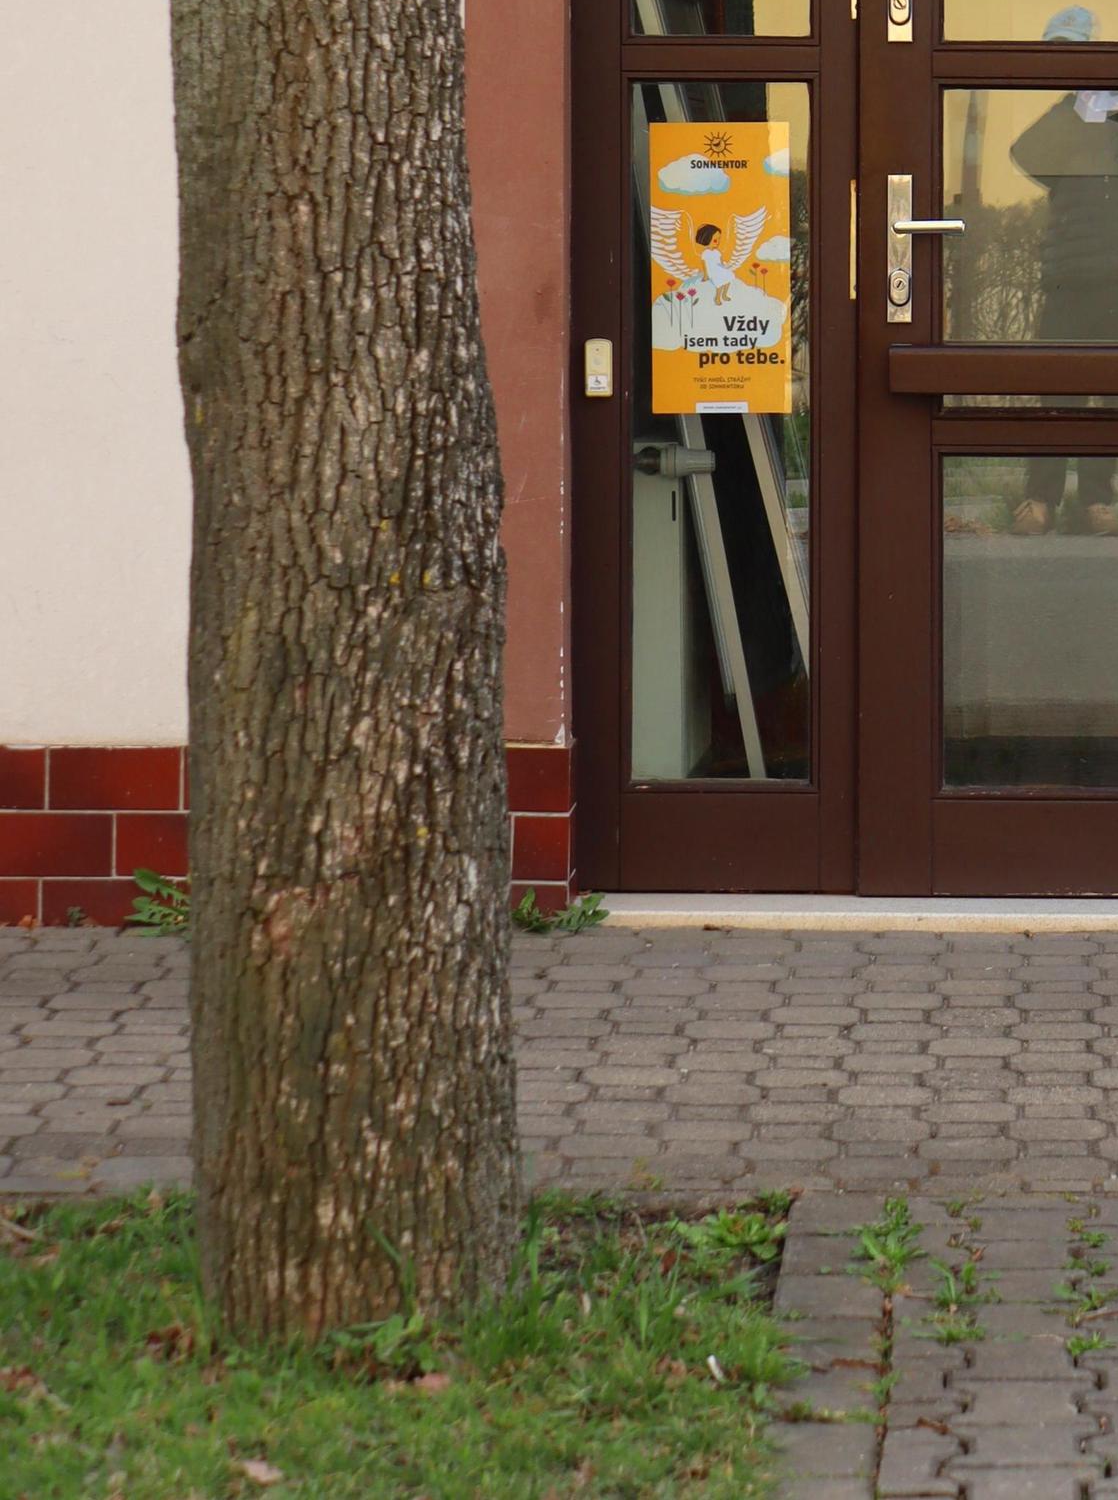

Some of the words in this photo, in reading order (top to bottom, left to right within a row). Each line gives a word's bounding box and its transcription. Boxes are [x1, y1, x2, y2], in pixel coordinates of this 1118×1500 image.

[690, 160, 748, 169] SONNENTOR
[723, 315, 770, 335] Vždy
[683, 334, 718, 350] jsem
[722, 334, 758, 350] tady
[699, 351, 731, 368] pro
[736, 348, 785, 365] tebe.
